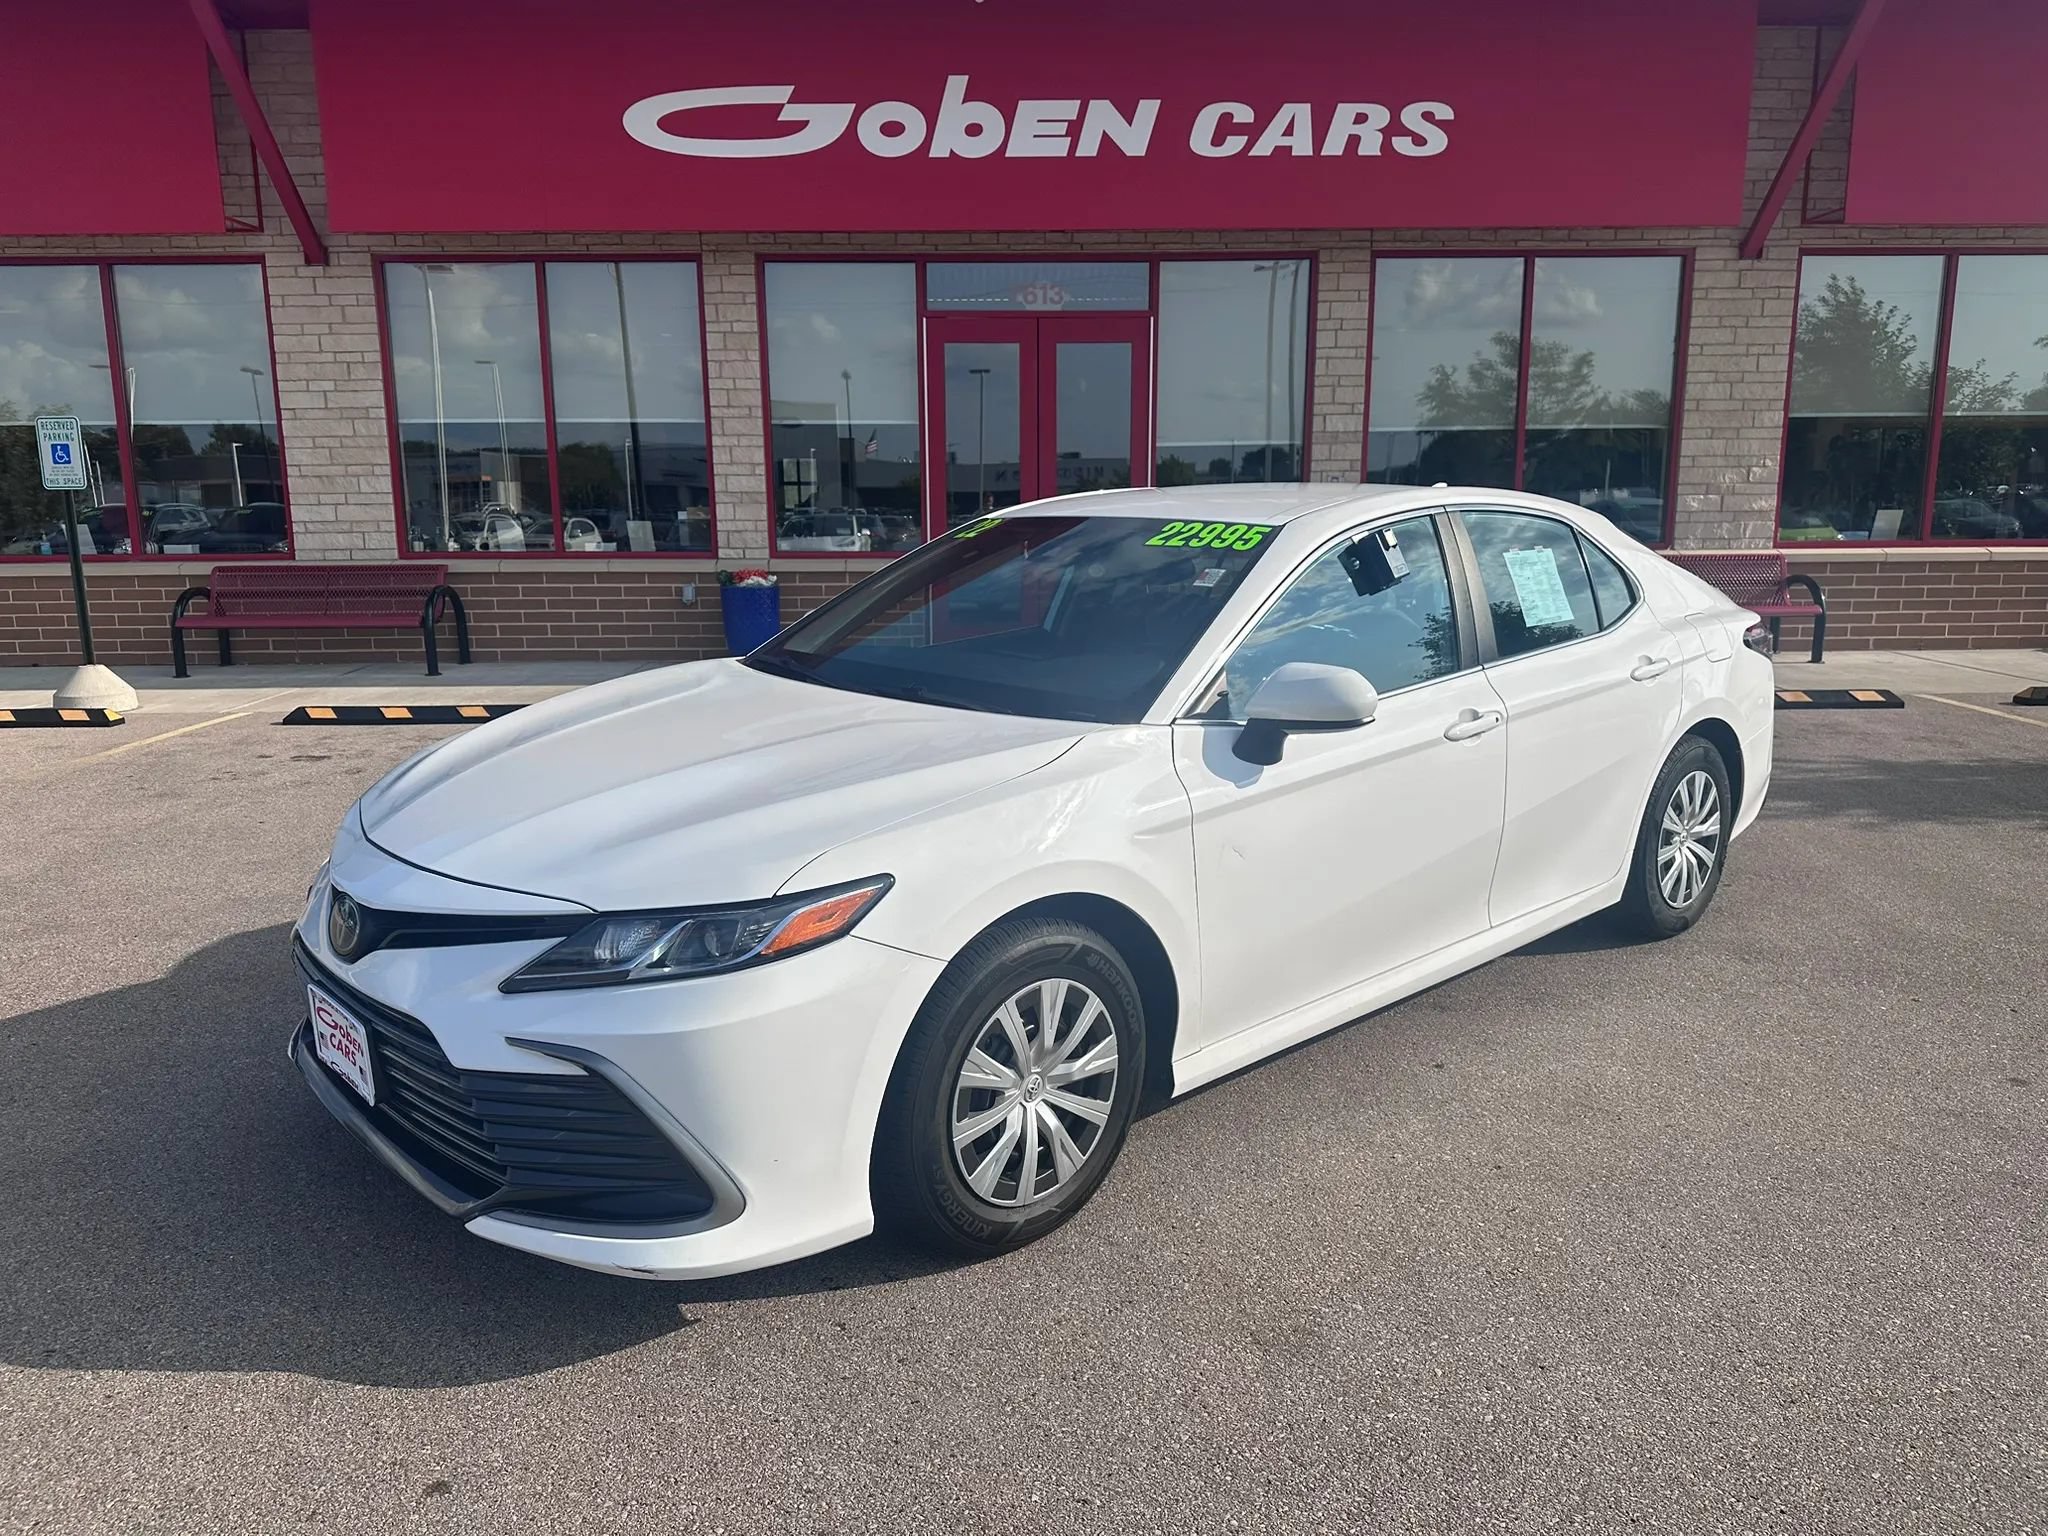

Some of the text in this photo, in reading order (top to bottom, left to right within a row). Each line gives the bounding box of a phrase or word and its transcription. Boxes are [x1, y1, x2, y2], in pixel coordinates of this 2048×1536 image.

[1188, 101, 1455, 158] CARS
[1022, 283, 1064, 305] 613
[40, 421, 75, 431] RESERVED
[43, 432, 75, 442] PARKING
[46, 477, 83, 486] THIS SPACE
[1144, 521, 1273, 552] 22995
[329, 1032, 357, 1067] CARS
